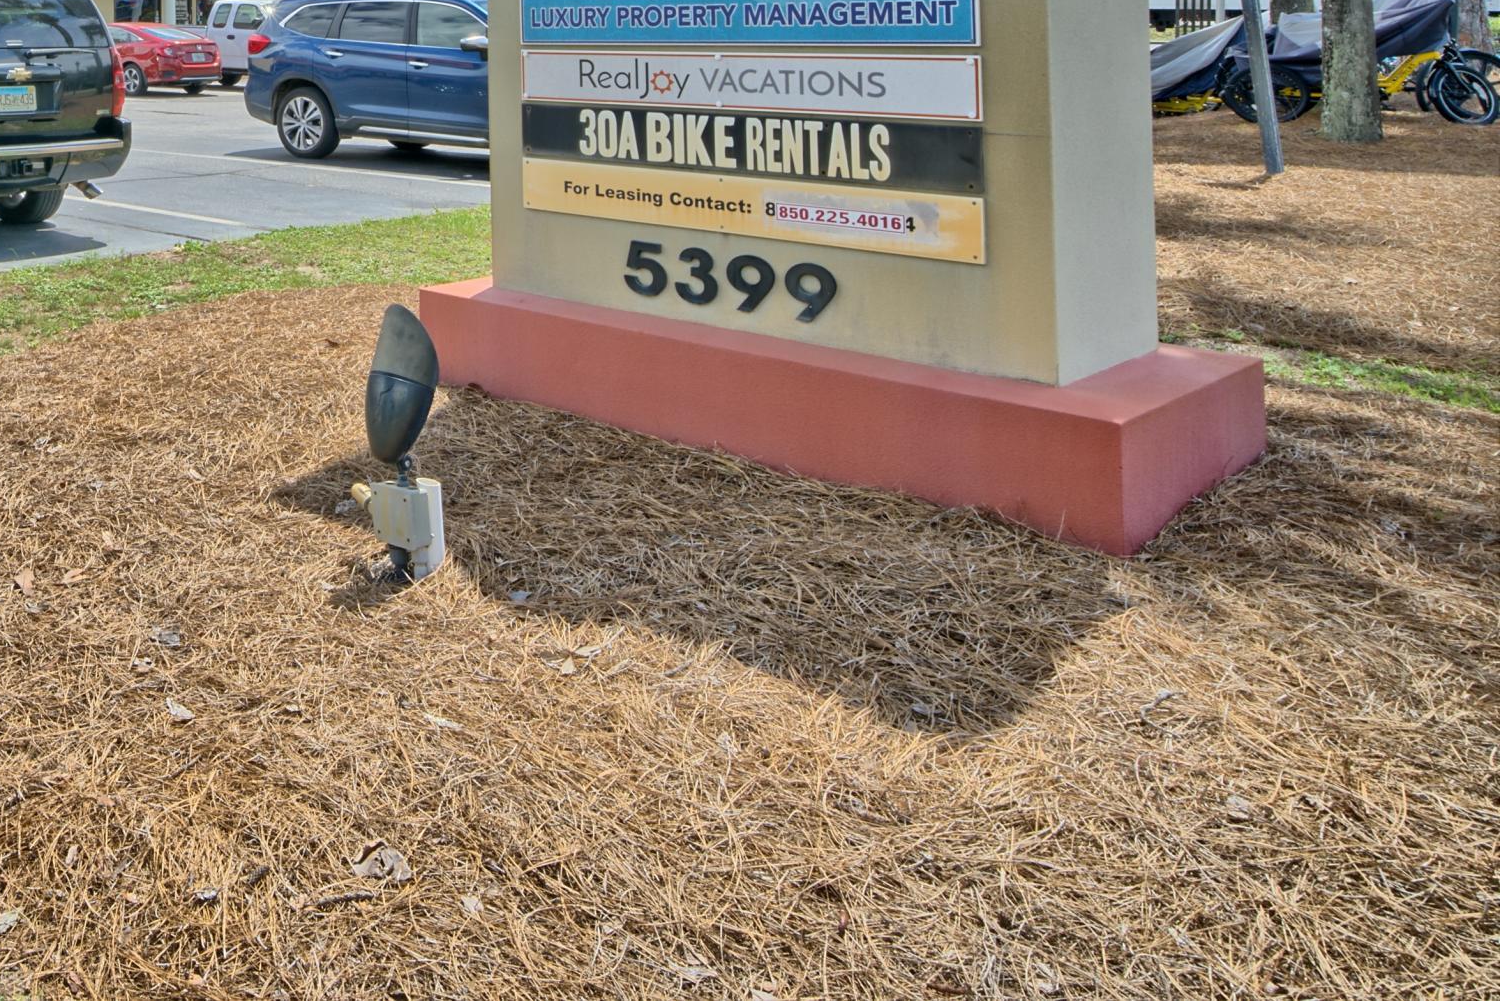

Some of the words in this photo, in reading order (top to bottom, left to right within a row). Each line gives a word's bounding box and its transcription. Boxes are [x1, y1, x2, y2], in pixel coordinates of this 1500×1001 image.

[531, 7, 611, 30] LUXURY
[616, 4, 736, 28] PROPERTY
[743, 0, 959, 27] MANAGEMENT
[699, 67, 888, 99] VACATIONS
[579, 108, 640, 161] 30A
[645, 111, 737, 170] BIKE
[745, 118, 892, 183] RENTALS
[563, 179, 591, 196] For
[594, 183, 664, 208] Leasing
[669, 191, 752, 215] Contact:
[623, 239, 839, 323] 5399
